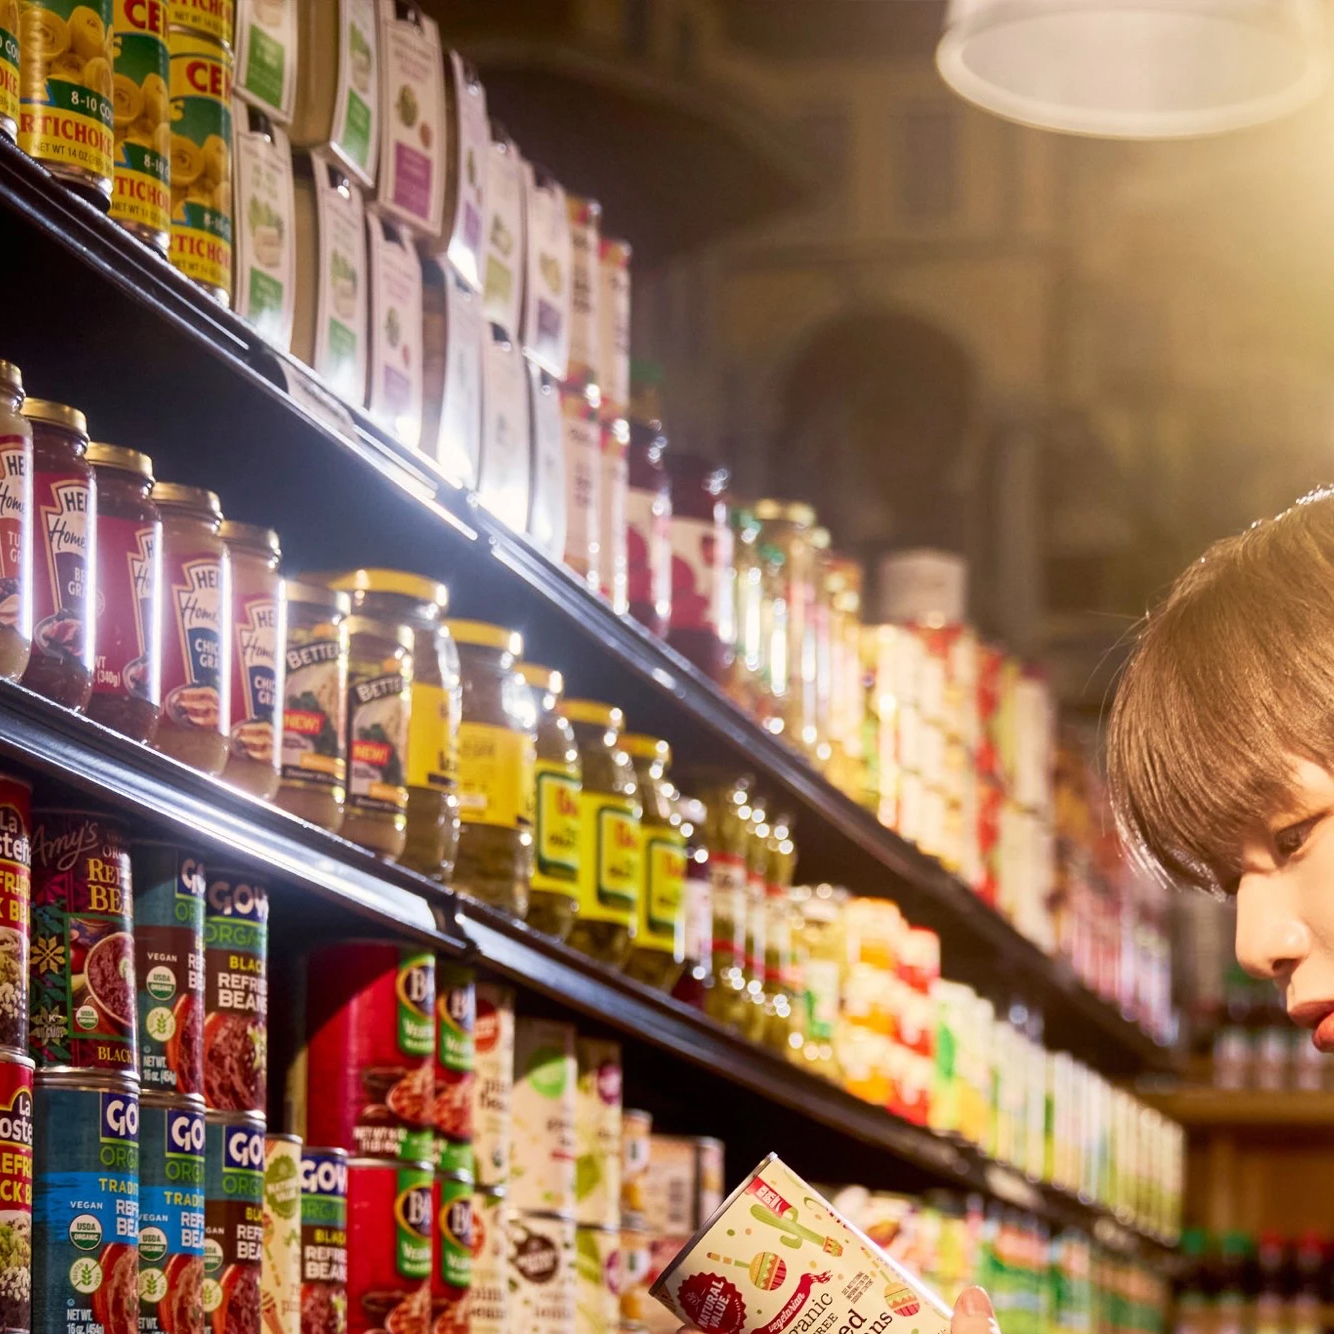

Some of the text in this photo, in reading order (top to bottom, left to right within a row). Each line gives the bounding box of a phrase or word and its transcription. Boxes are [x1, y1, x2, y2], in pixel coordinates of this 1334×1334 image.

[71, 91, 97, 112] 8-10
[52, 145, 65, 154] WT
[68, 147, 77, 157] 14
[31, 820, 99, 871] Amy's
[147, 952, 177, 962] VEGAN
[153, 973, 171, 982] USDA
[19, 1095, 31, 1117] La
[70, 1201, 103, 1210] VEGAN
[77, 1222, 96, 1231] USDA
[74, 1233, 99, 1241] ORGANIC
[142, 1234, 161, 1243] USDA
[697, 1281, 724, 1328] NATURAL
[67, 1309, 80, 1321] NET
[709, 1295, 730, 1329] VALUE
[767, 1292, 806, 1333] vegetarian
[67, 1323, 75, 1334] 16
